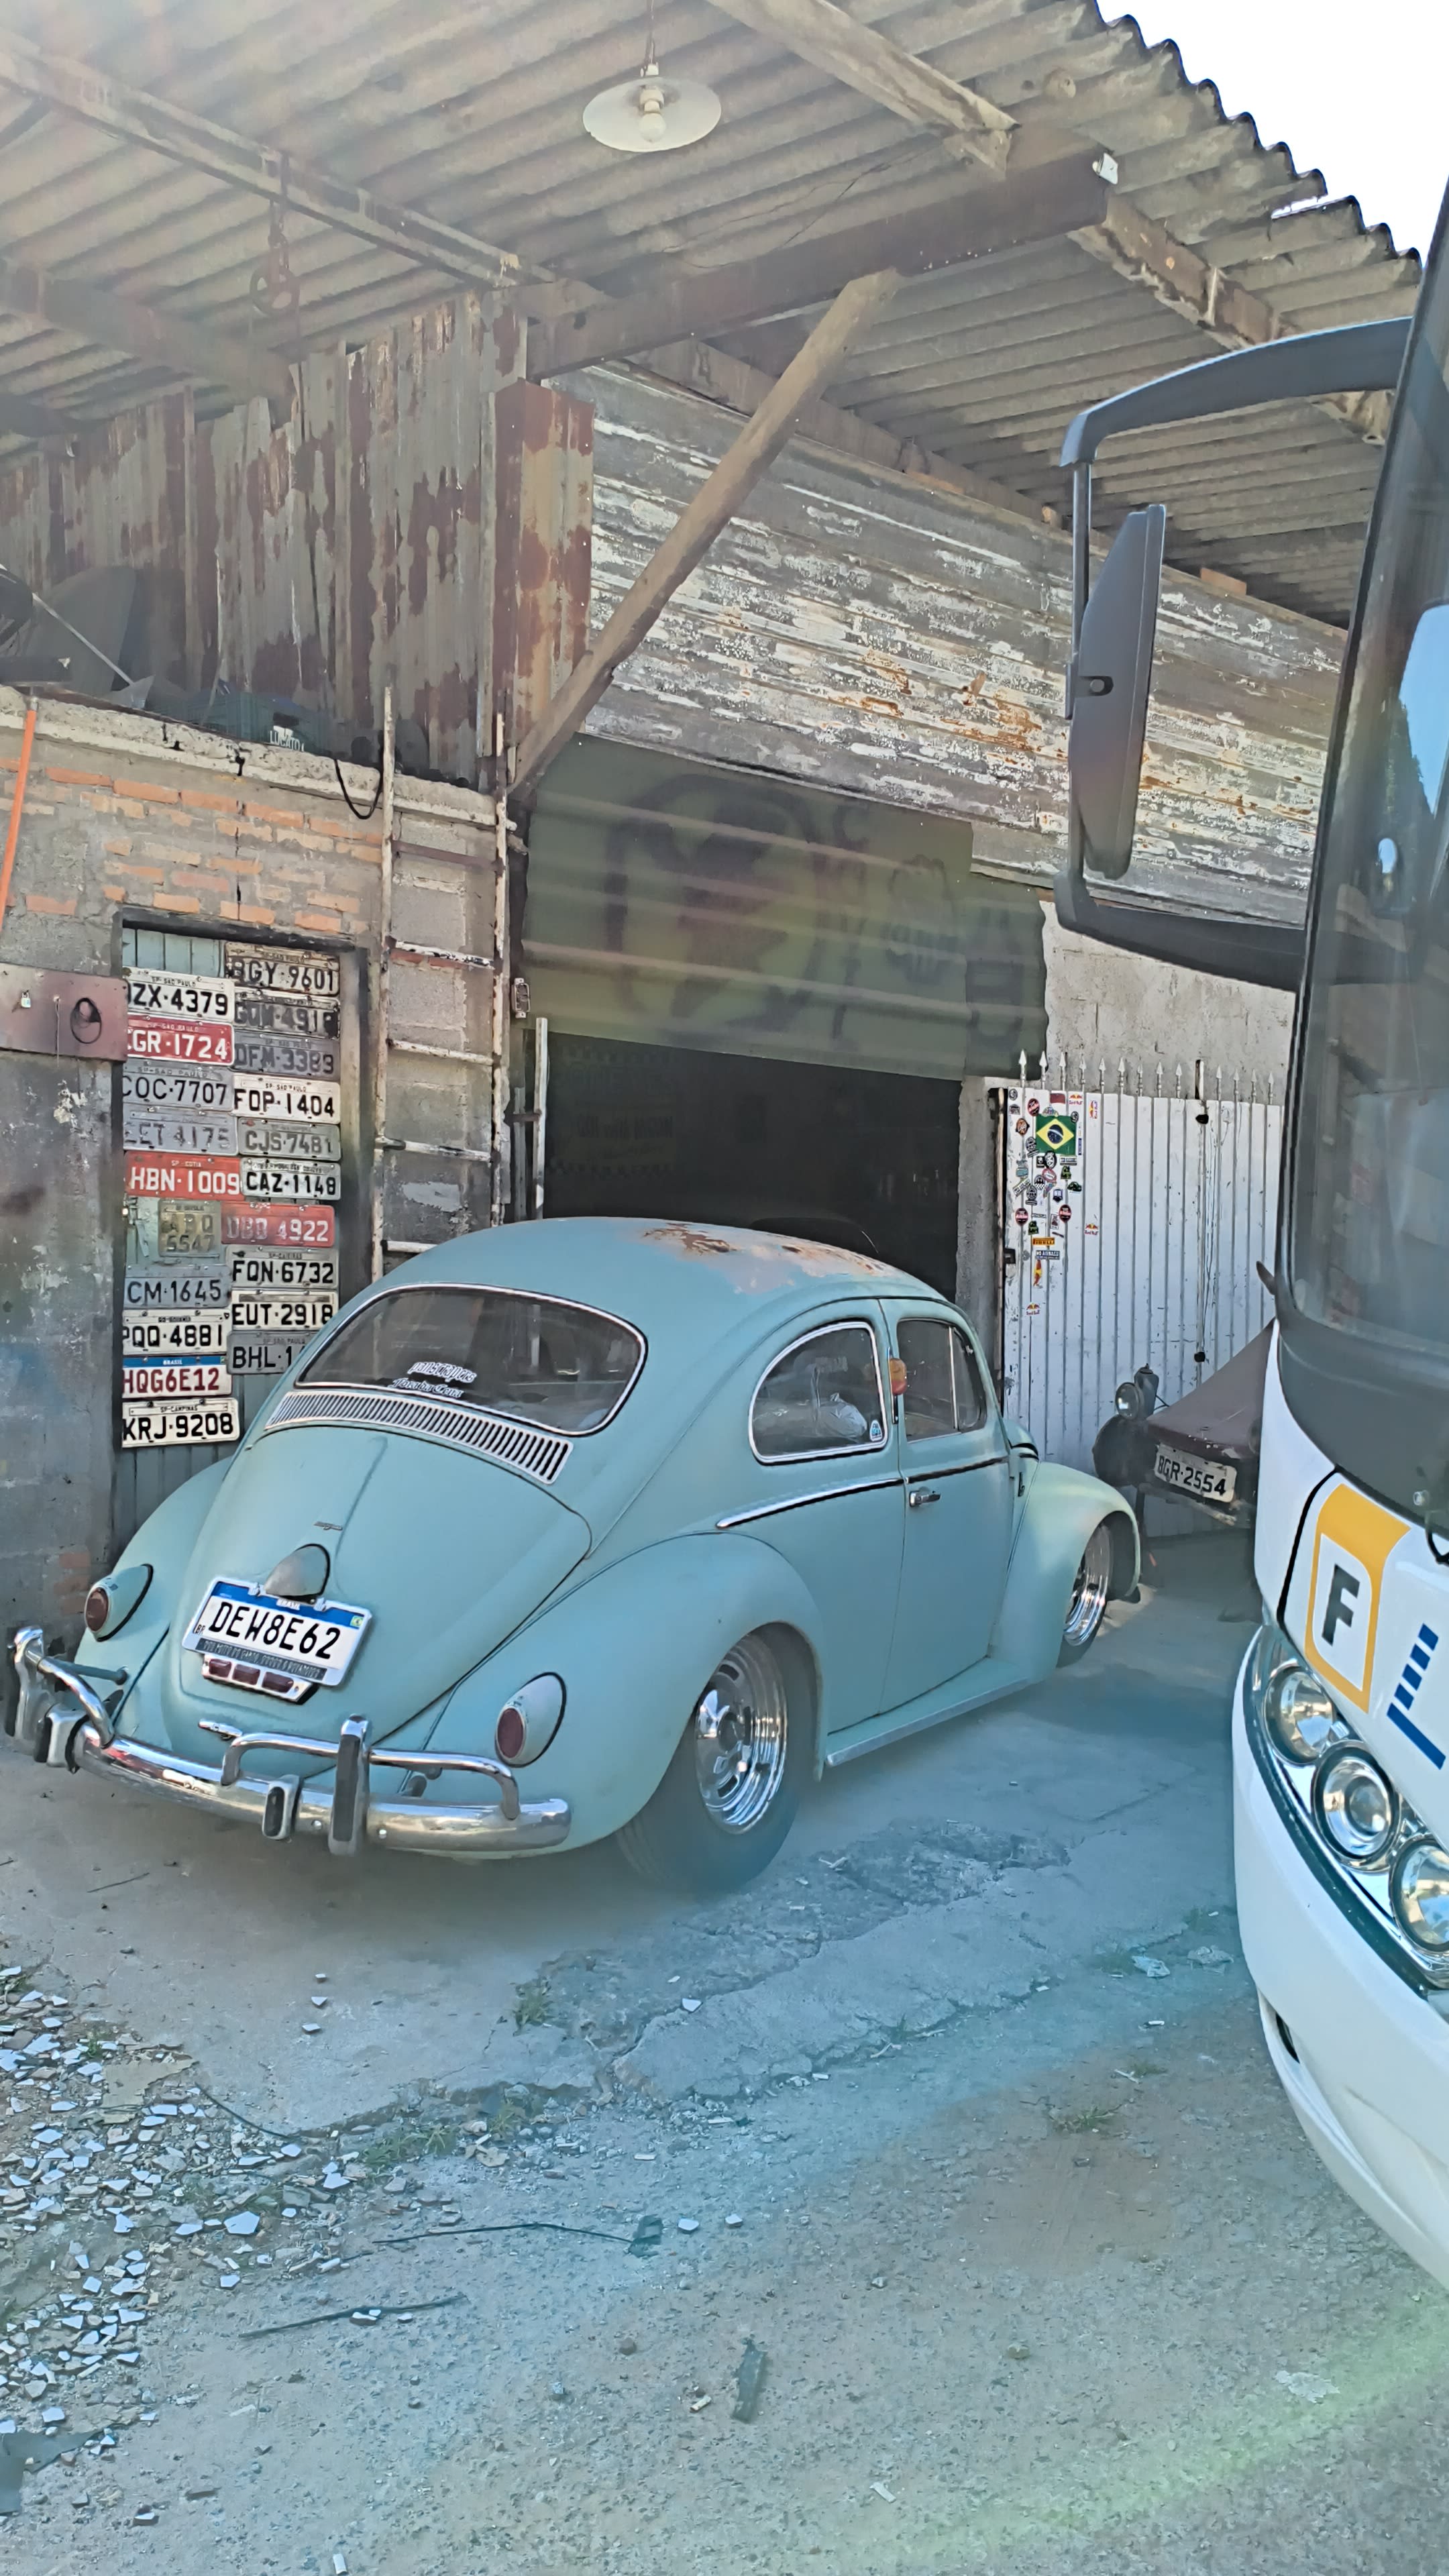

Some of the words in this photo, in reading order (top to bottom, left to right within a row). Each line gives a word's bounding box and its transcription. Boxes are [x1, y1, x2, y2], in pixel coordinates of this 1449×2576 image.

[127, 983, 228, 1016] ZX·4379
[122, 1367, 220, 1394] HQG6E12
[1322, 1564, 1360, 1646] F
[209, 1601, 341, 1660] DEW8E62
